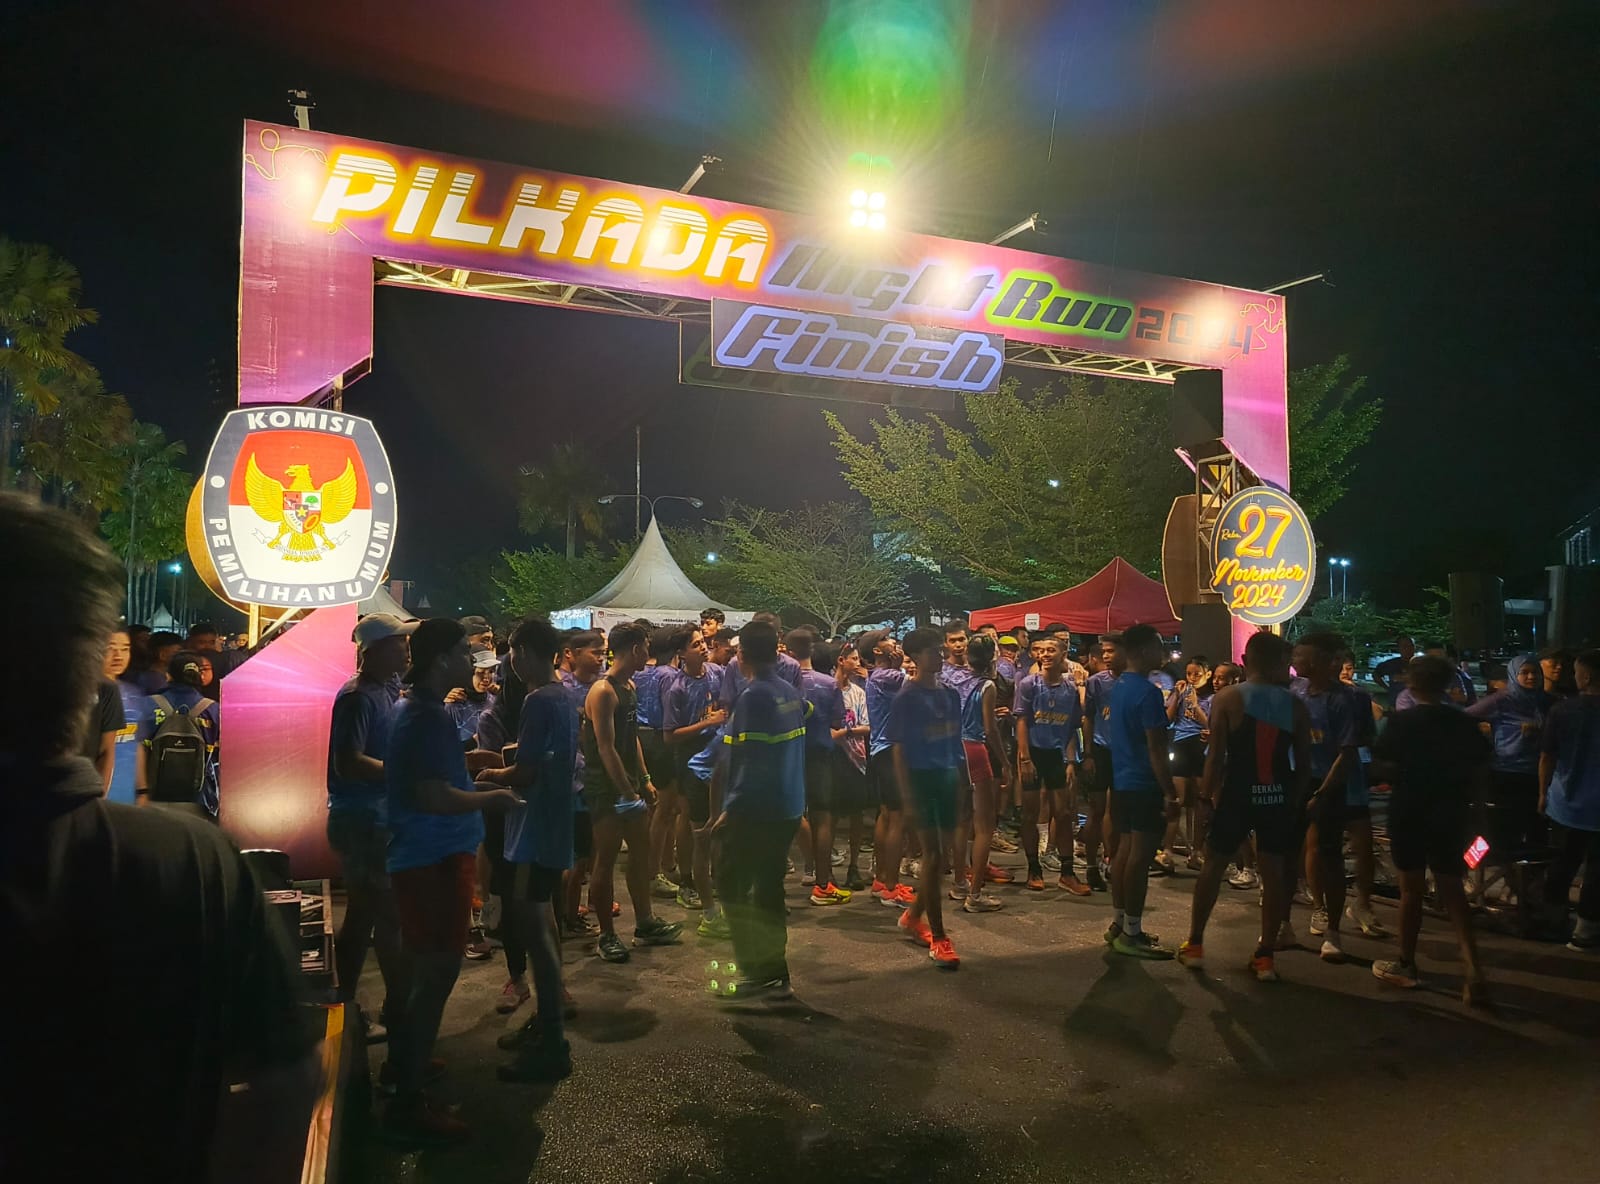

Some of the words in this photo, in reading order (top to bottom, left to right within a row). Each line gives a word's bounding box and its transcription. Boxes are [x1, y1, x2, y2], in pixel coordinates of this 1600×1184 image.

[311, 152, 769, 284] PILKADA
[992, 277, 1134, 338] Run
[719, 309, 1001, 388] Finish
[247, 410, 356, 436] KOMISI
[1235, 504, 1293, 559] 27
[208, 518, 336, 602] PEMILIHAN
[344, 520, 391, 598] UMUM
[1212, 557, 1306, 587] November
[1230, 582, 1287, 609] 2024
